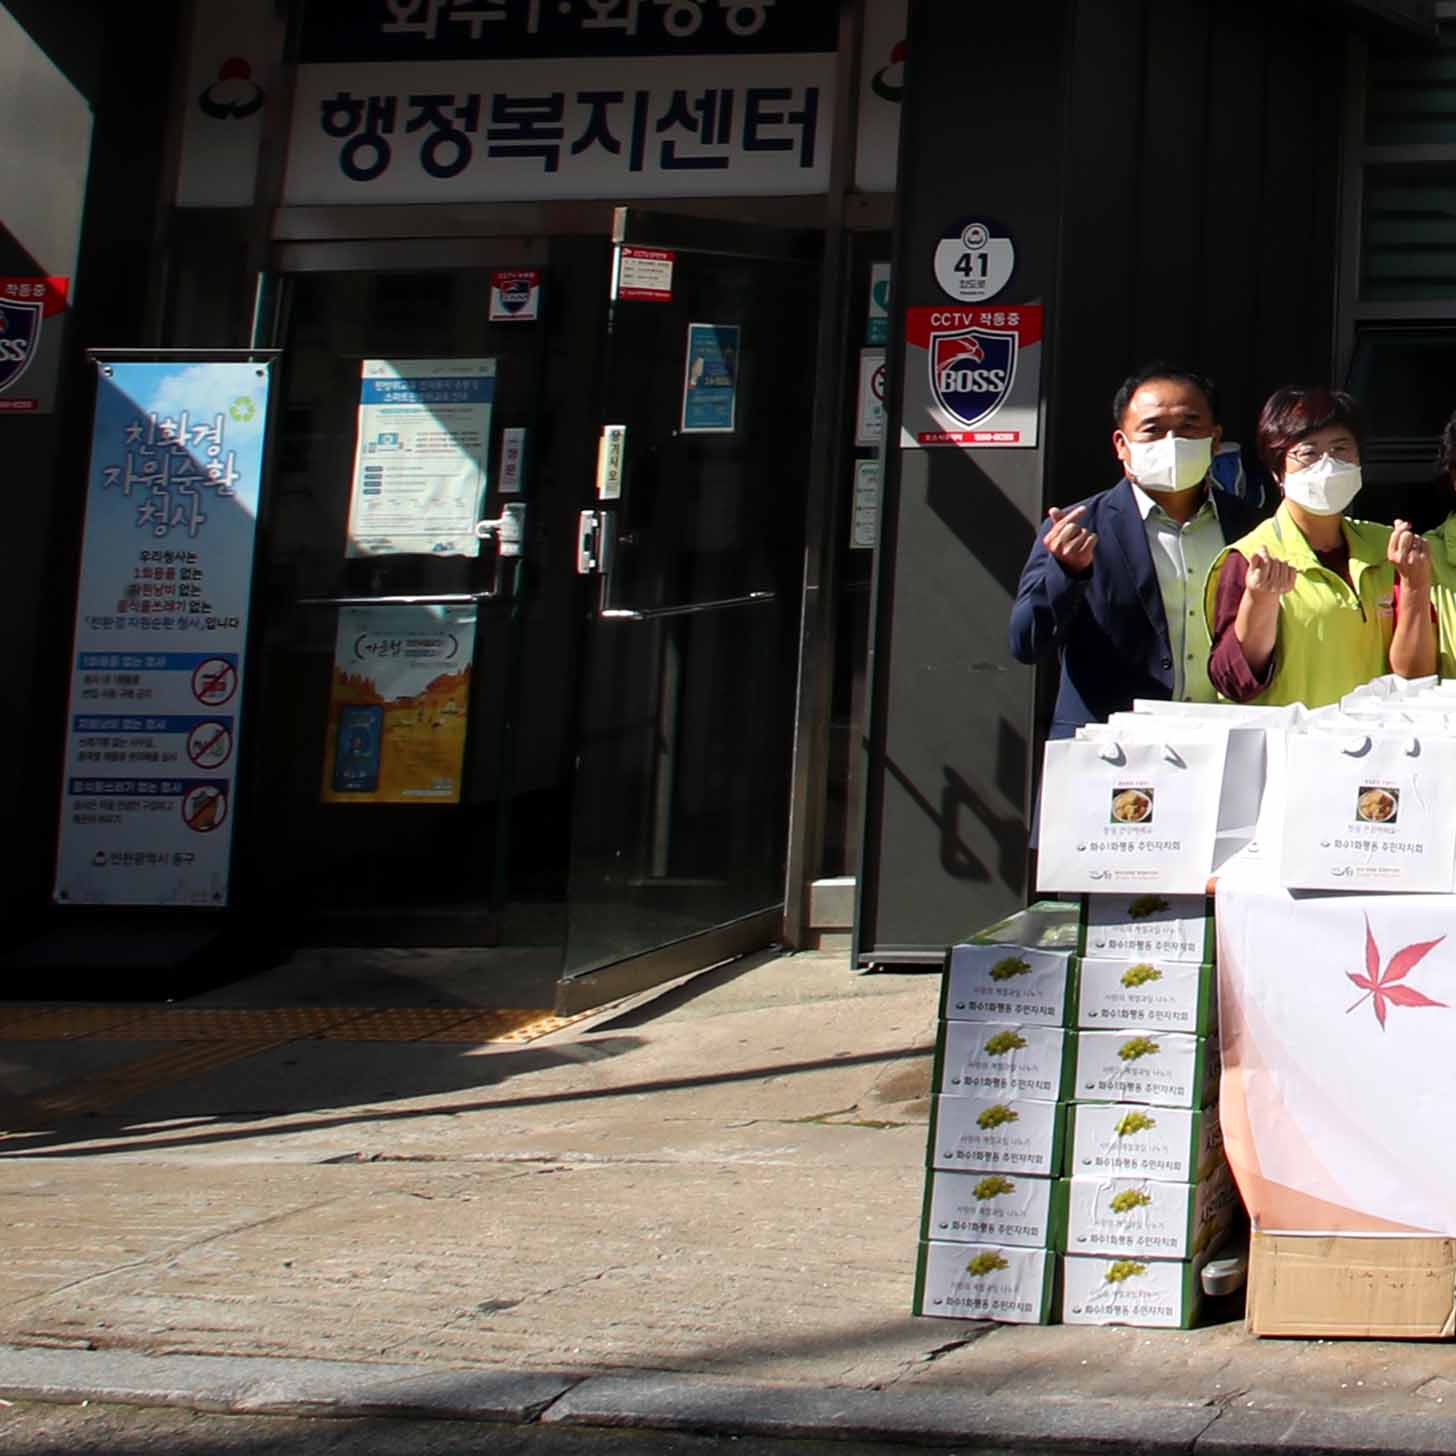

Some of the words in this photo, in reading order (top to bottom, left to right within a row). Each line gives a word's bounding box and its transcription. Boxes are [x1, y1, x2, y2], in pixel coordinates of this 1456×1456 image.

[320, 87, 820, 182] 행정복지센터
[954, 252, 989, 278] 41
[930, 312, 973, 327] CCTV
[979, 312, 1021, 328] 작동중
[940, 369, 1006, 394] BOSS
[125, 409, 224, 457] 친환경
[103, 450, 240, 497] 자원순환
[137, 494, 206, 537] 청사
